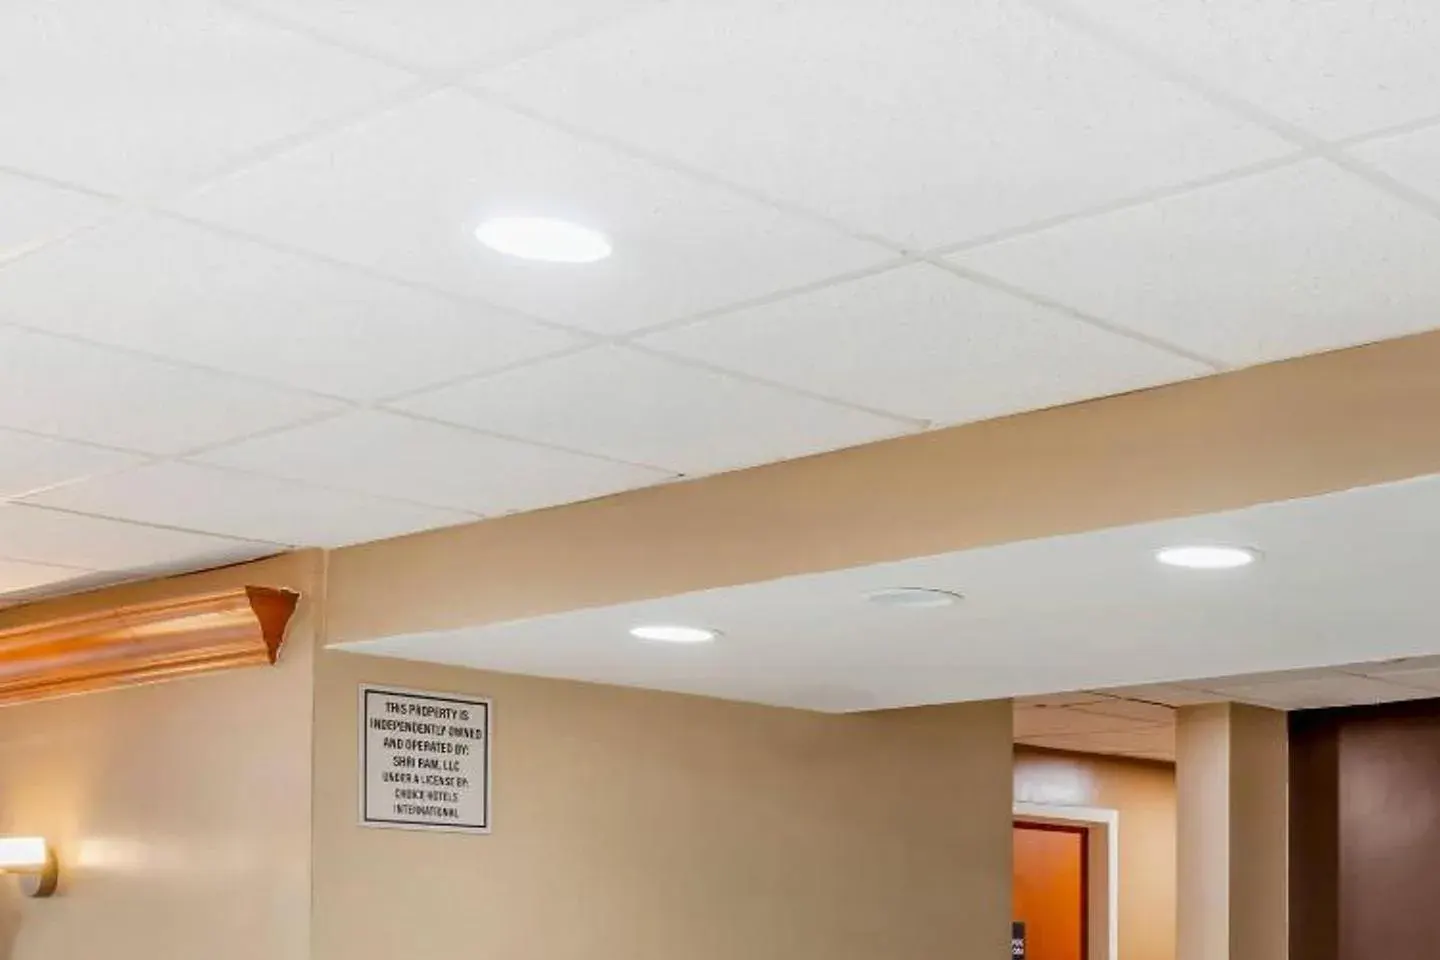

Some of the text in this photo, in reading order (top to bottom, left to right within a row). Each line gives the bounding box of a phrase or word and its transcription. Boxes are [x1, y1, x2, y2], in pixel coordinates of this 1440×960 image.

[386, 702, 470, 720] THIS PROPERTY IS
[370, 718, 482, 739] INDEPENDENTLY OWNED
[384, 737, 403, 750] AND
[405, 739, 453, 753] OPERATED
[443, 760, 460, 772] LLC
[382, 772, 411, 782] UNDER
[414, 775, 419, 784] A
[422, 775, 454, 786] LICENSE
[395, 788, 459, 802] CHOICE HOTELS
[393, 803, 459, 818] INTERNATIONAL
